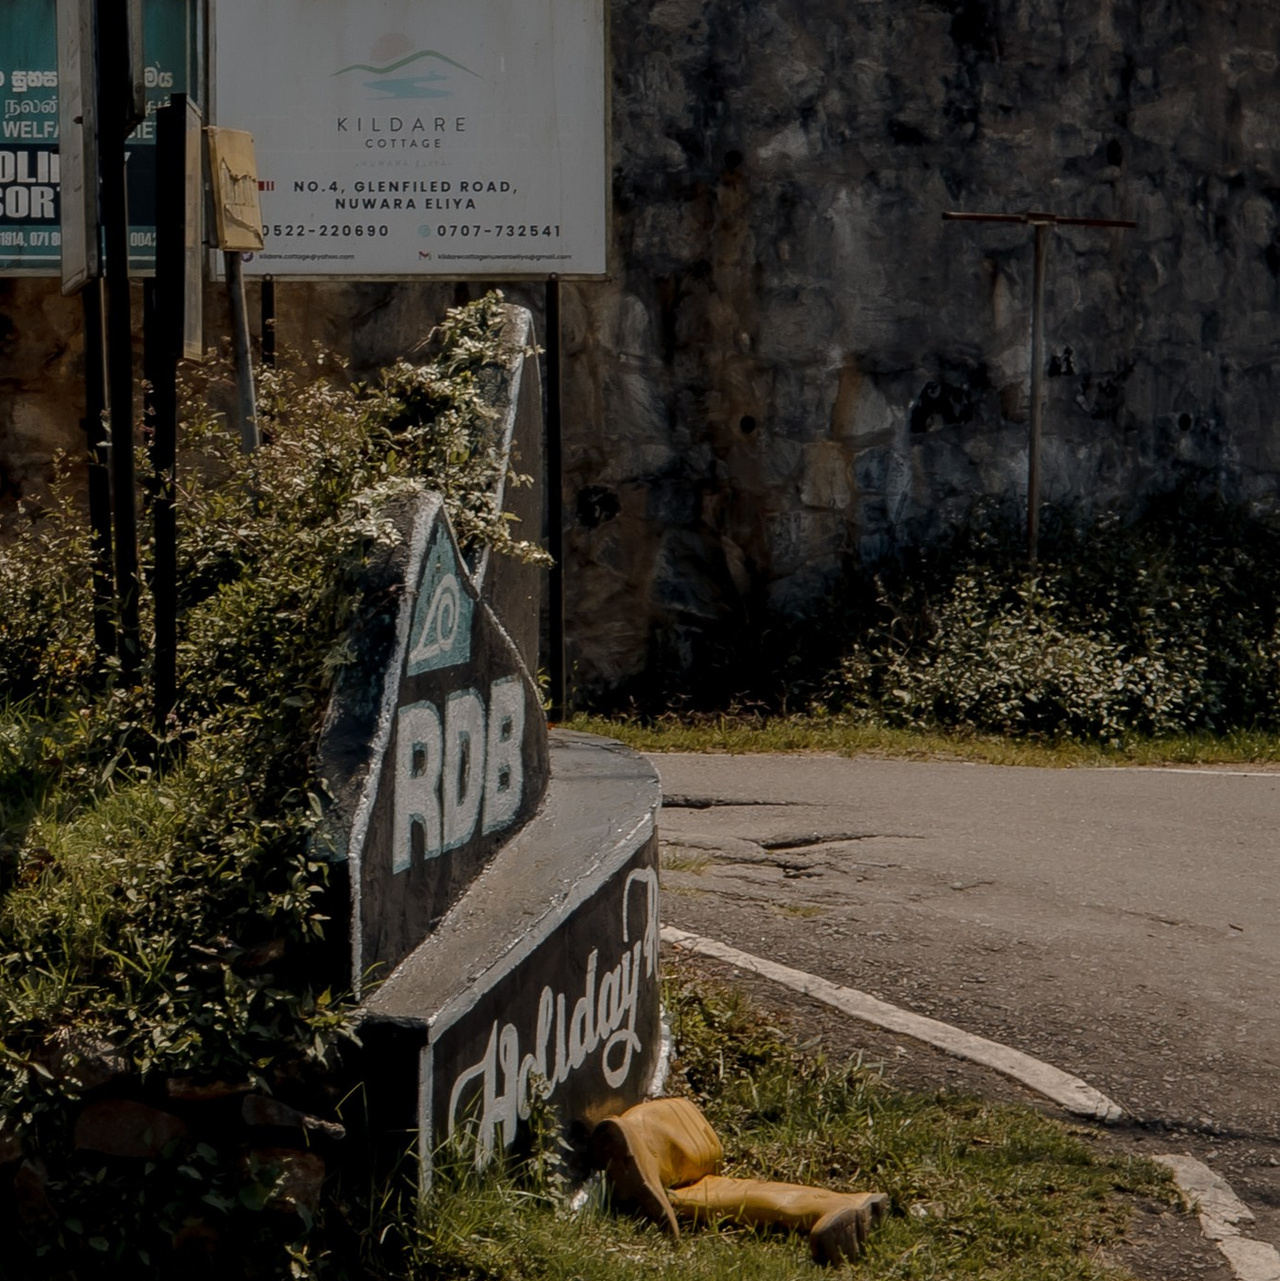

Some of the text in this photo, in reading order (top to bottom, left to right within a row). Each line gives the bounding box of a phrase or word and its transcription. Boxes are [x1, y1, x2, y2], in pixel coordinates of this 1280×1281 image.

[4, 95, 59, 119] நலன்
[2, 121, 60, 138] WELF
[337, 117, 467, 132] KILDARE
[365, 138, 442, 149] COTTAGE
[293, 181, 518, 194] NO.4, GLENFILED ROAD,
[335, 198, 477, 210] NUWARA ELIYA
[30, 231, 50, 246] 071
[261, 225, 390, 238] 0522-220690
[437, 225, 561, 238] 0707-732541
[393, 673, 526, 875] RDB
[448, 940, 642, 1178] Holiday
